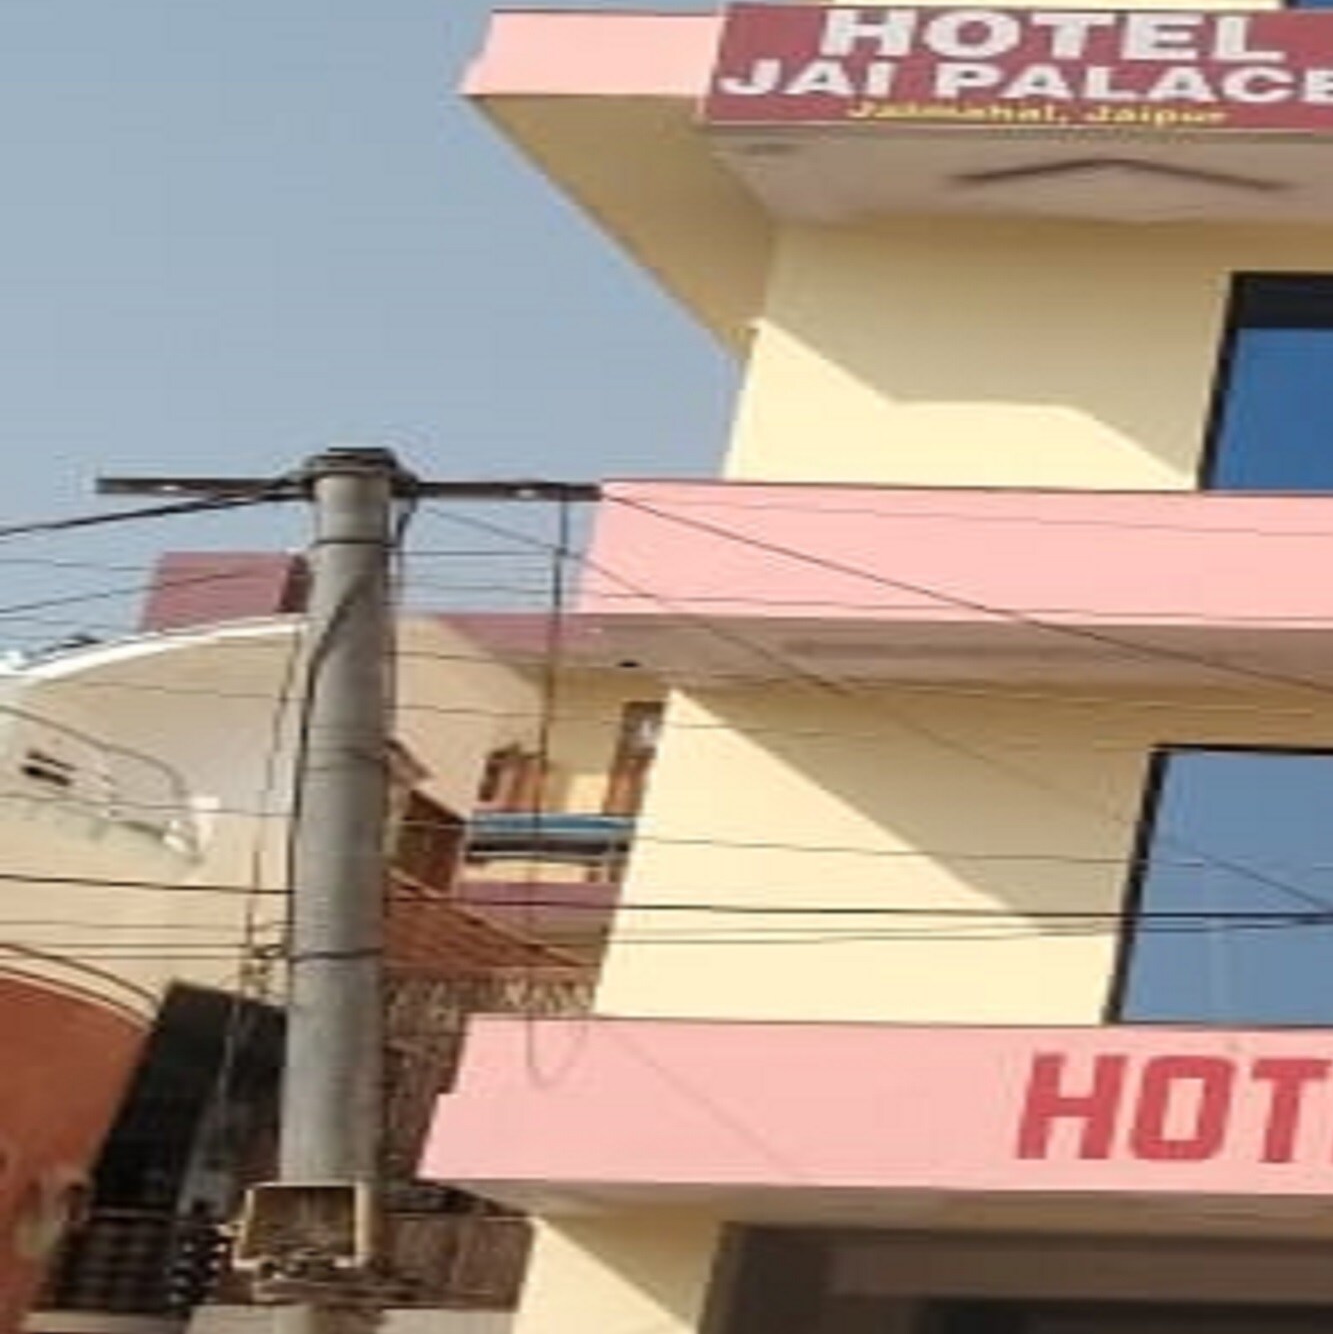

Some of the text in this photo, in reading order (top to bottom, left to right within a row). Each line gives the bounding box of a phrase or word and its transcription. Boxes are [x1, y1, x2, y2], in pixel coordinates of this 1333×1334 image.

[819, 9, 1286, 62] HOTEL
[719, 60, 897, 96] JAI
[1086, 103, 1229, 127] Jaipur
